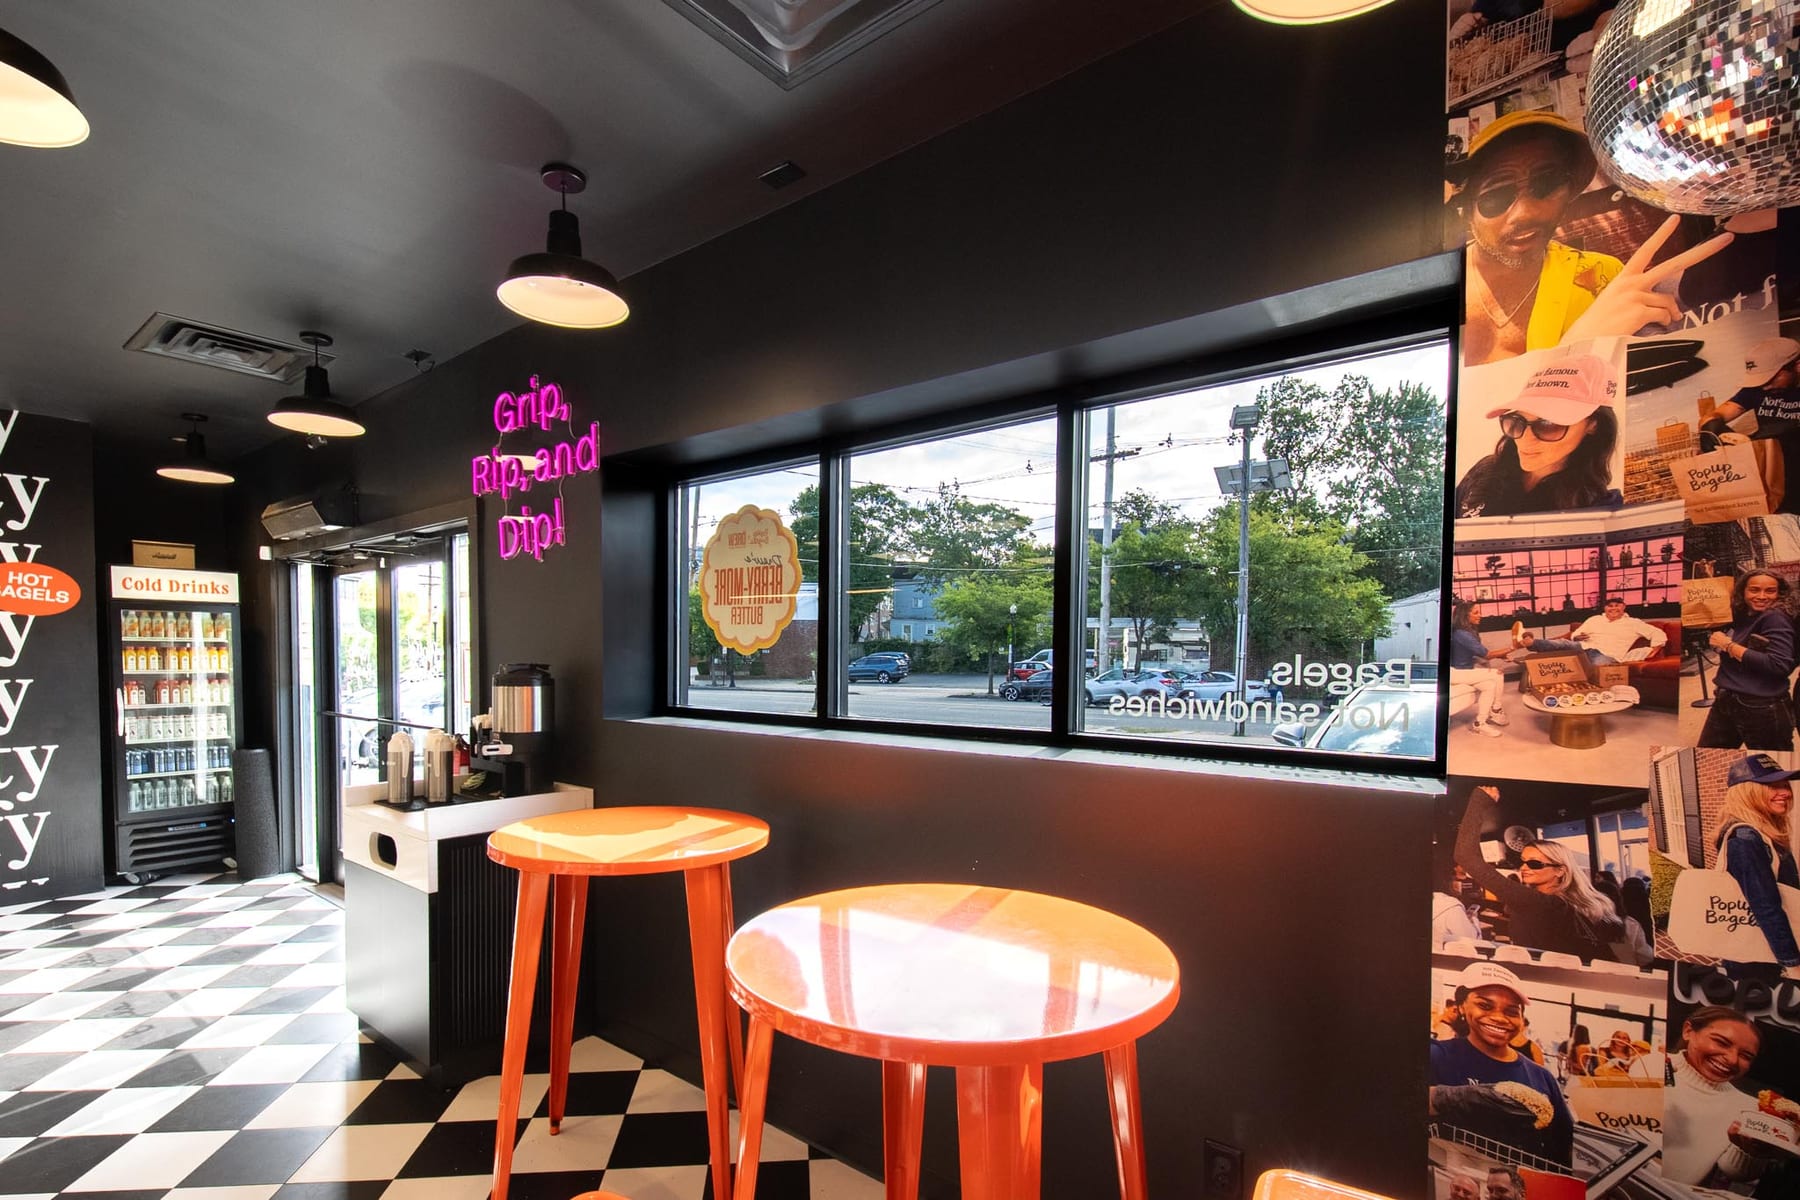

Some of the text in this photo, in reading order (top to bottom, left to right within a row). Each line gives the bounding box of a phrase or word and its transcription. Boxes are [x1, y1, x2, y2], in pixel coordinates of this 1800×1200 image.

[494, 374, 570, 432] Grip,
[472, 421, 600, 499] Rip, and
[1690, 471, 1747, 493] Bagels
[499, 497, 565, 561] Dip!
[8, 571, 53, 587] HOT
[121, 576, 229, 595] Cold Drinks
[0, 586, 70, 604] AGELS
